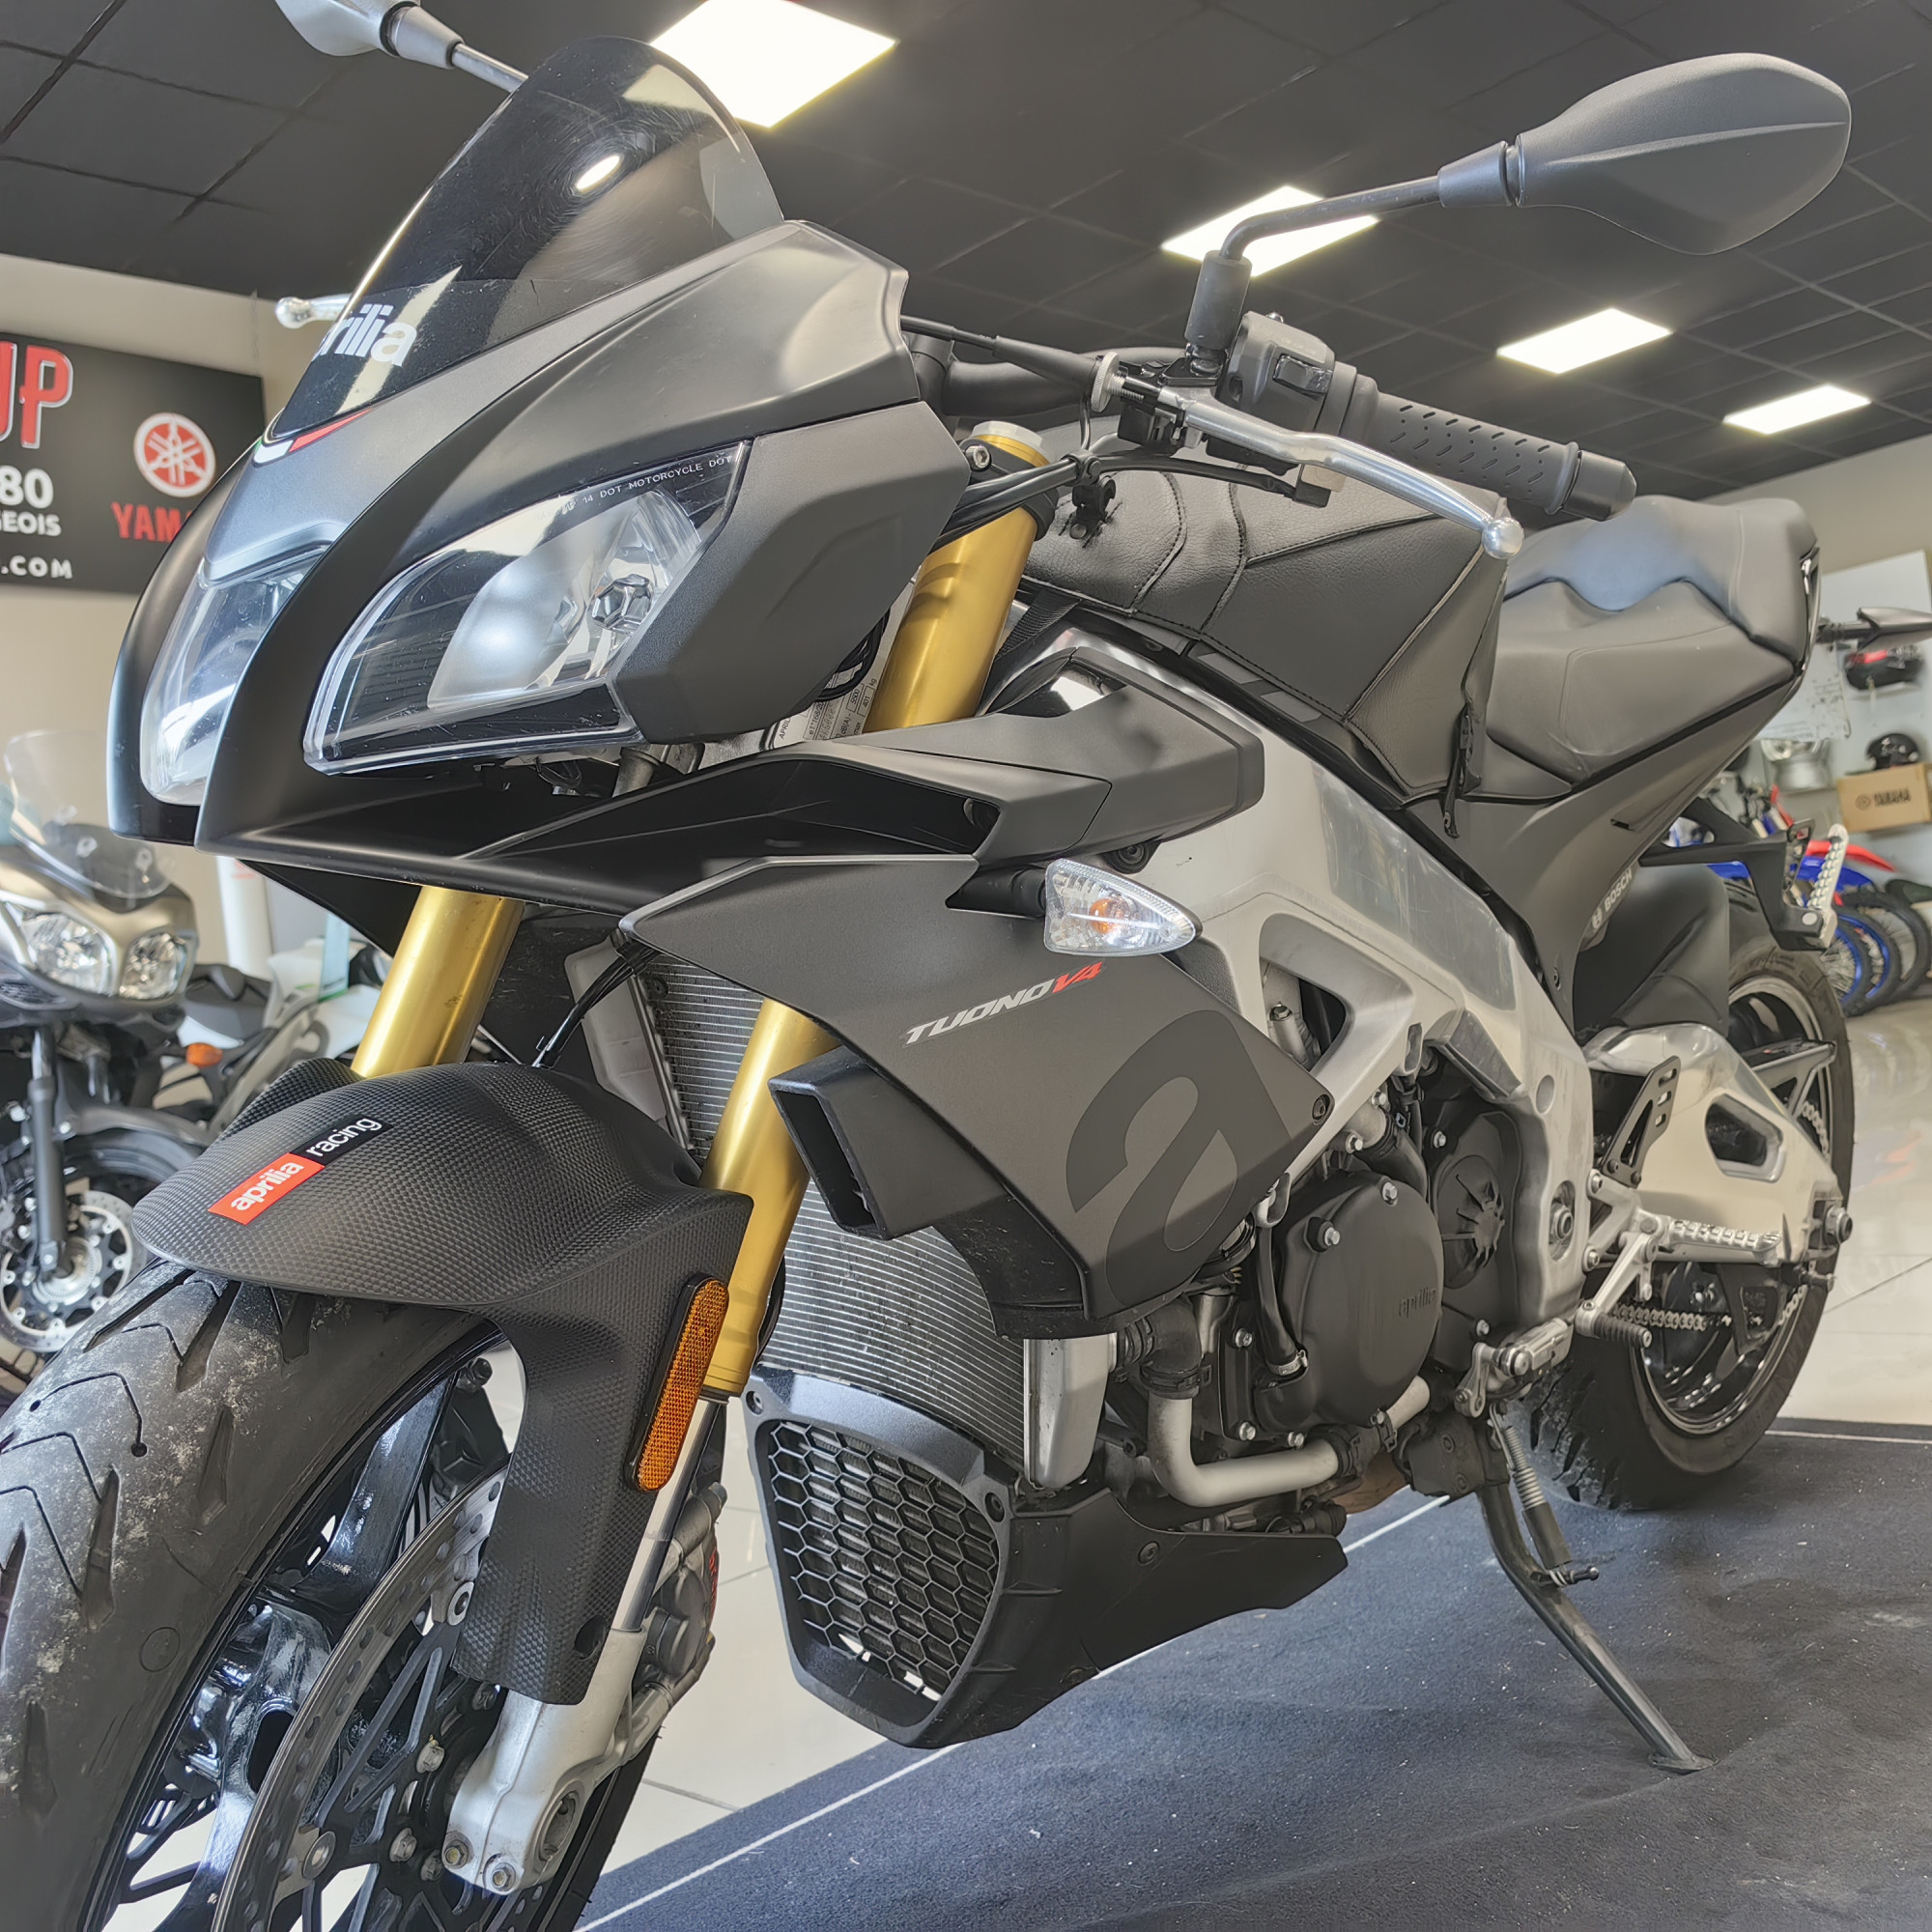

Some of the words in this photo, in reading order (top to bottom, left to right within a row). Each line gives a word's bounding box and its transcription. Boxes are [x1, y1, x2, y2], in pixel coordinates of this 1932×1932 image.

[310, 303, 417, 367] rilia
[582, 494, 594, 503] 14
[600, 486, 623, 498] DOT
[628, 464, 703, 490] MOTORCYCLE
[708, 455, 732, 469] DOT
[0, 509, 62, 537] EOIS
[110, 500, 193, 543] YAM
[1604, 867, 1633, 912] BOSCH
[231, 1162, 304, 1211] aprilia
[305, 1118, 383, 1157] racing
